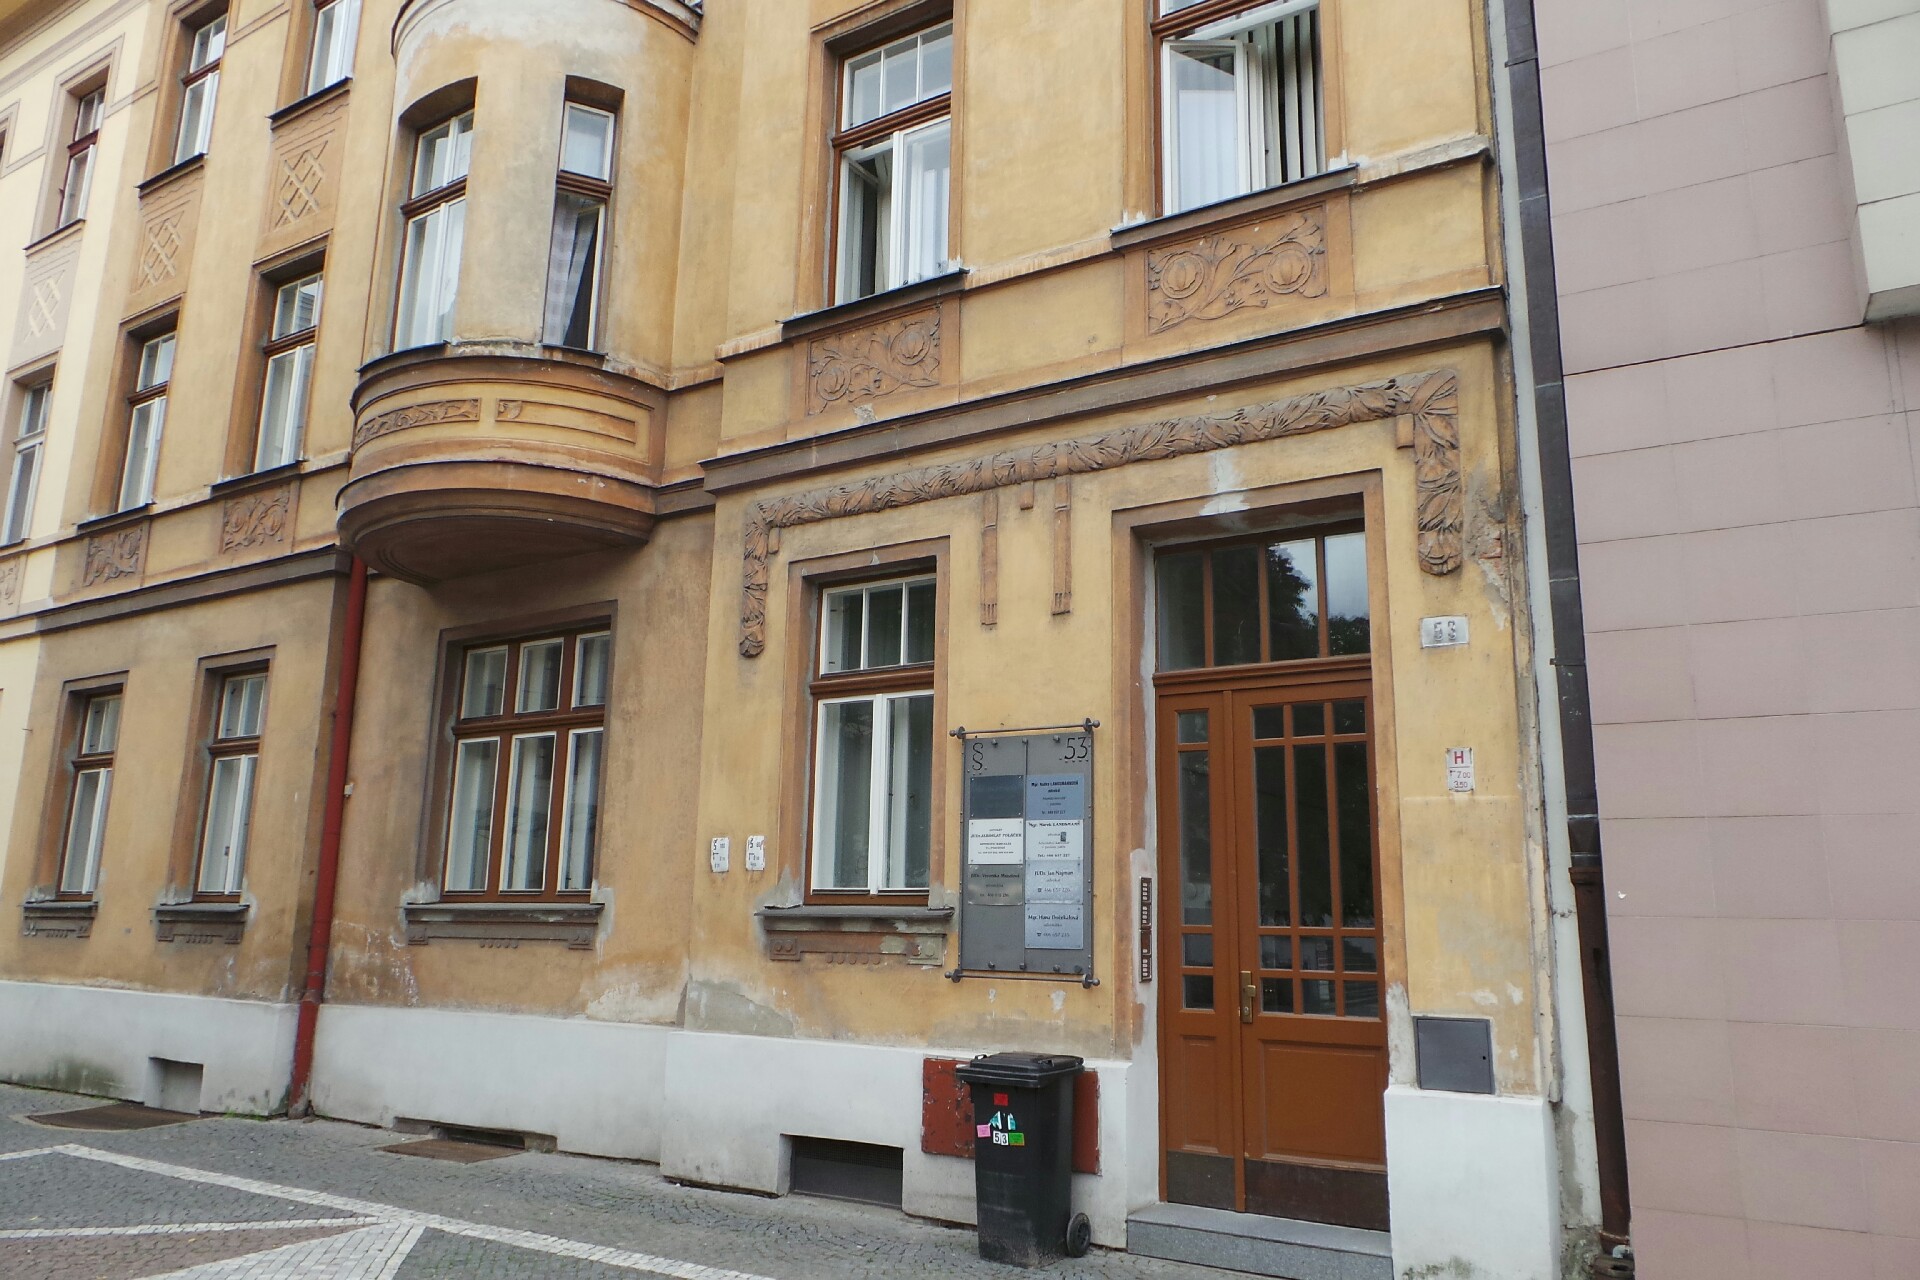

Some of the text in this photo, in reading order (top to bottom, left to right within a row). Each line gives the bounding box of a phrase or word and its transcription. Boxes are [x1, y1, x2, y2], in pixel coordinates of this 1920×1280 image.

[1433, 620, 1457, 641] 53
[1064, 736, 1088, 760] 53
[1454, 751, 1464, 764] H
[994, 1132, 1007, 1144] 53
